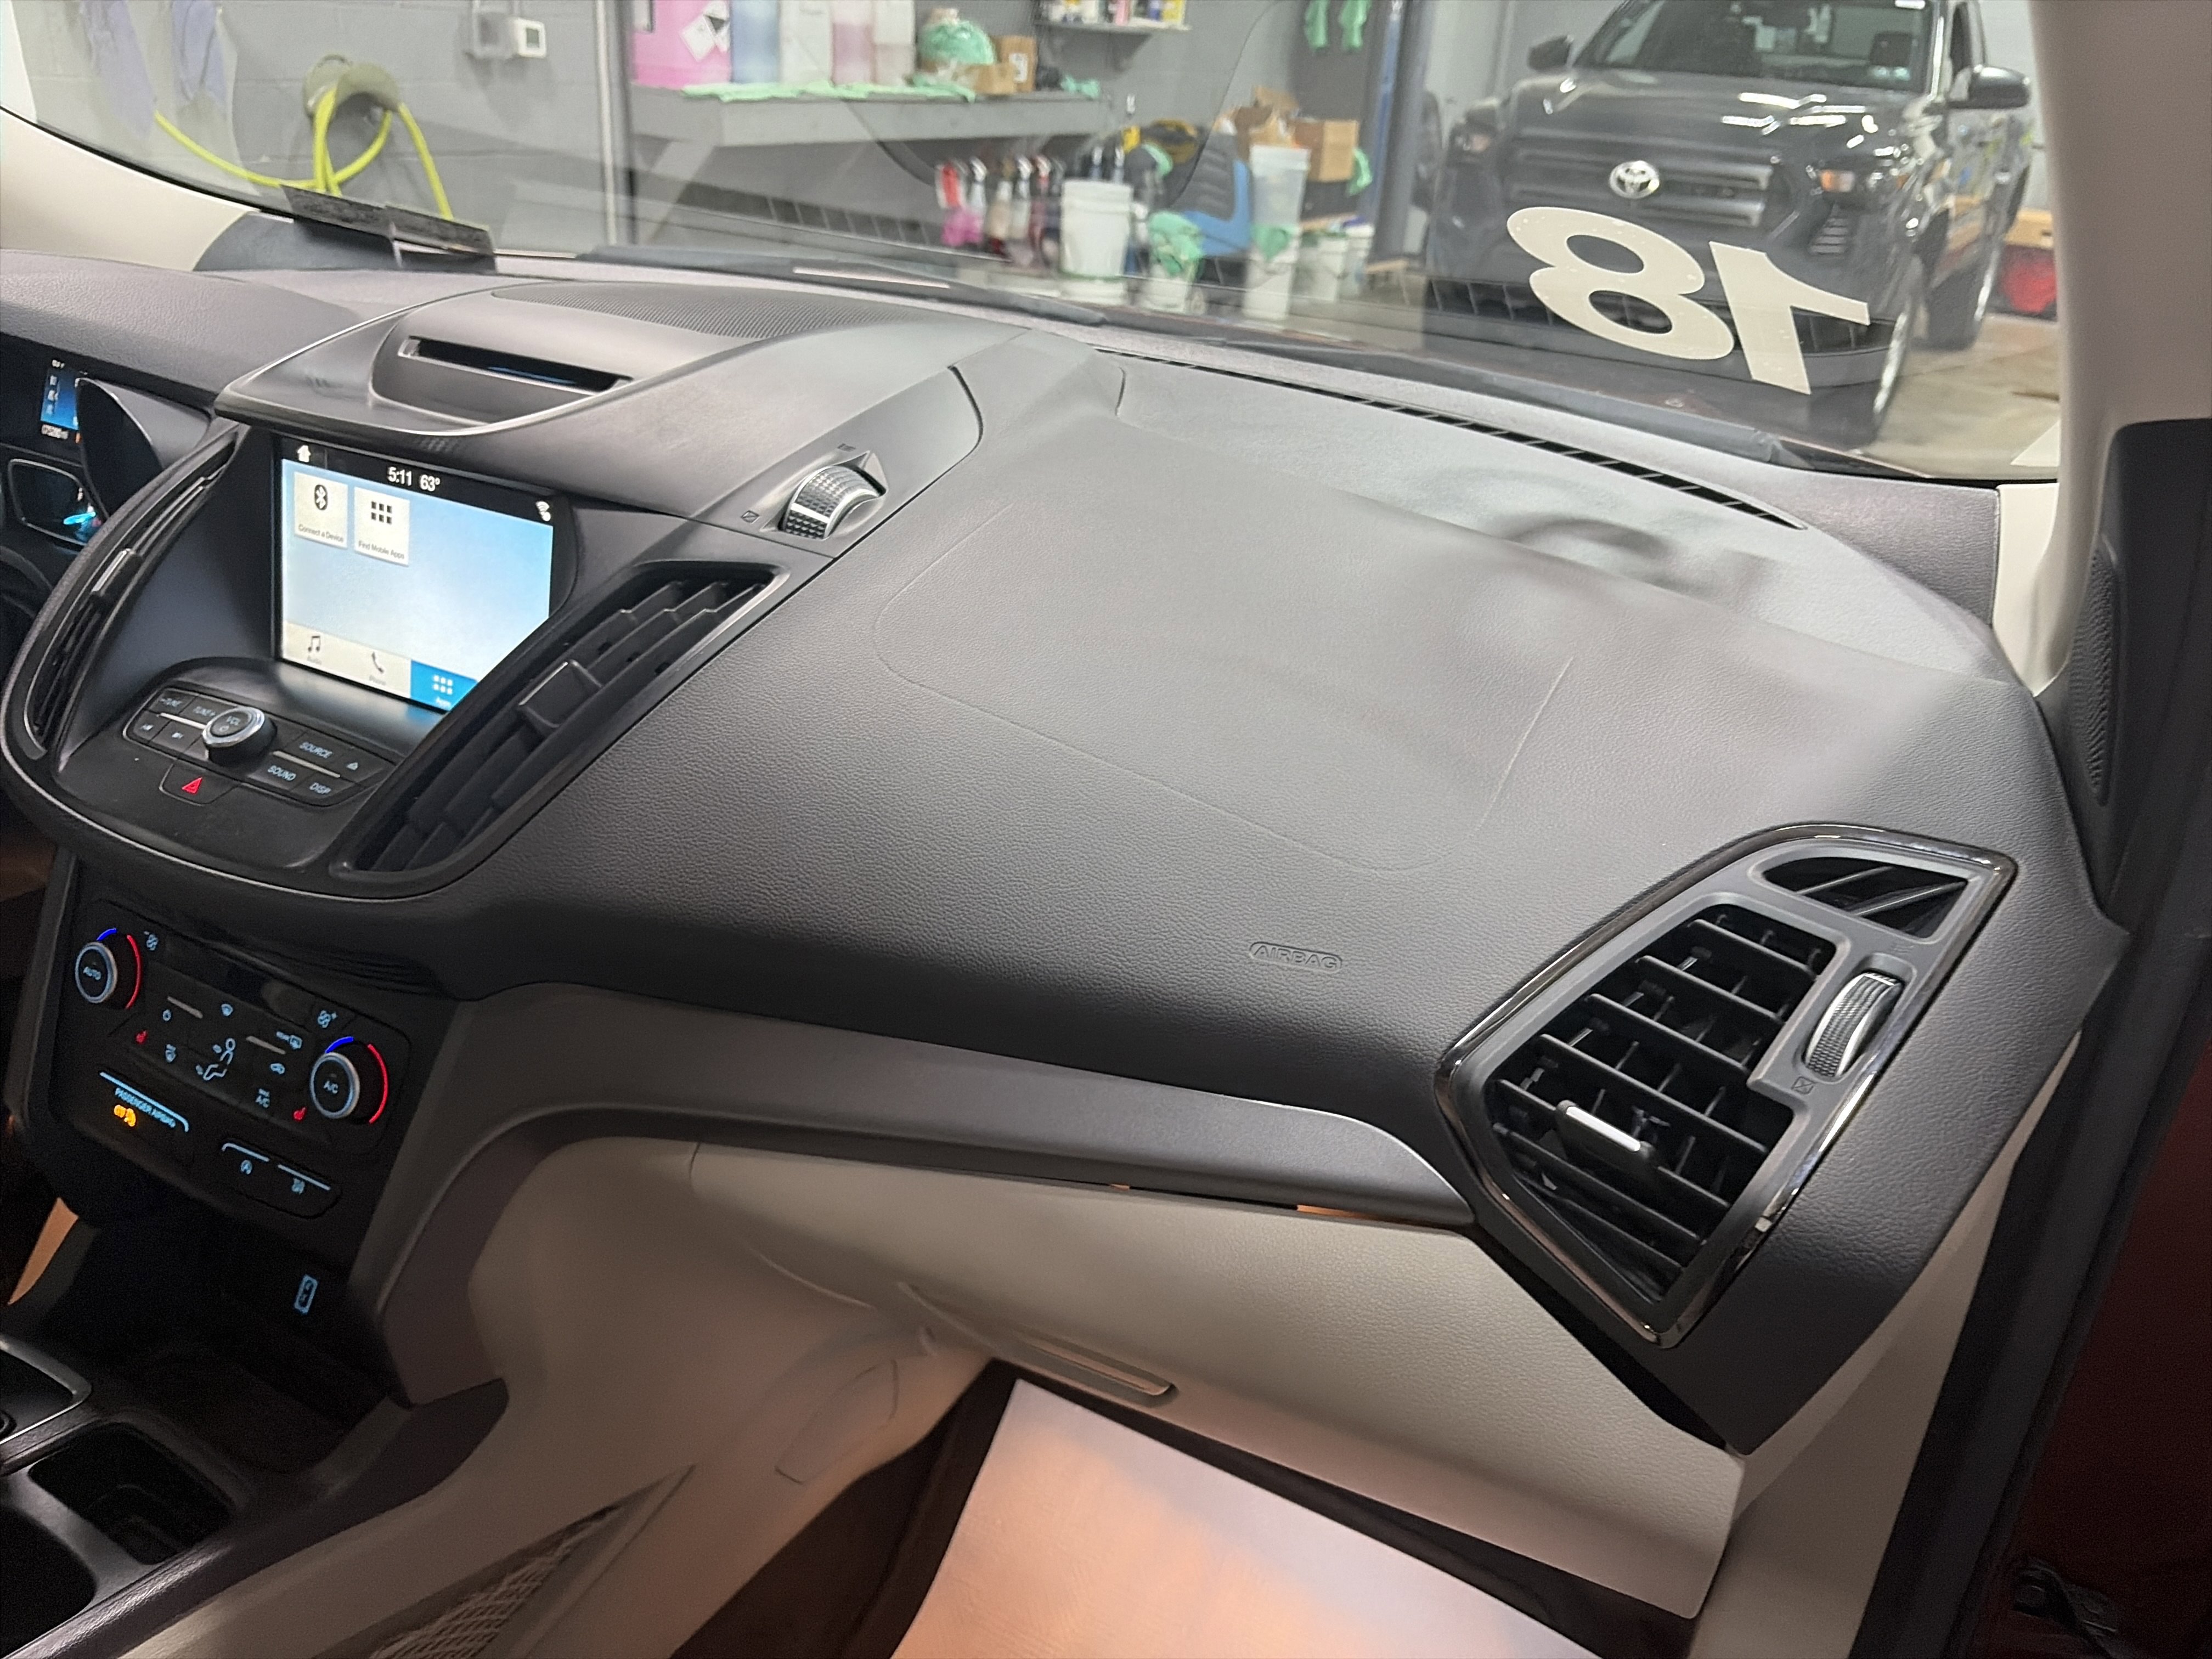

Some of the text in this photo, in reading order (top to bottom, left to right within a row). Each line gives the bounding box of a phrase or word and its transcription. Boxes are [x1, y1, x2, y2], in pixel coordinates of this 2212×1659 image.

[387, 466, 441, 492] 5:11 63°
[298, 523, 320, 537] Connect
[326, 531, 344, 543] Device
[358, 540, 405, 560] Find Mobile Apps
[299, 741, 333, 759] SOURCE
[267, 765, 297, 781] SOUND
[309, 782, 331, 794] DISP
[1253, 945, 1337, 969] AIRBAG
